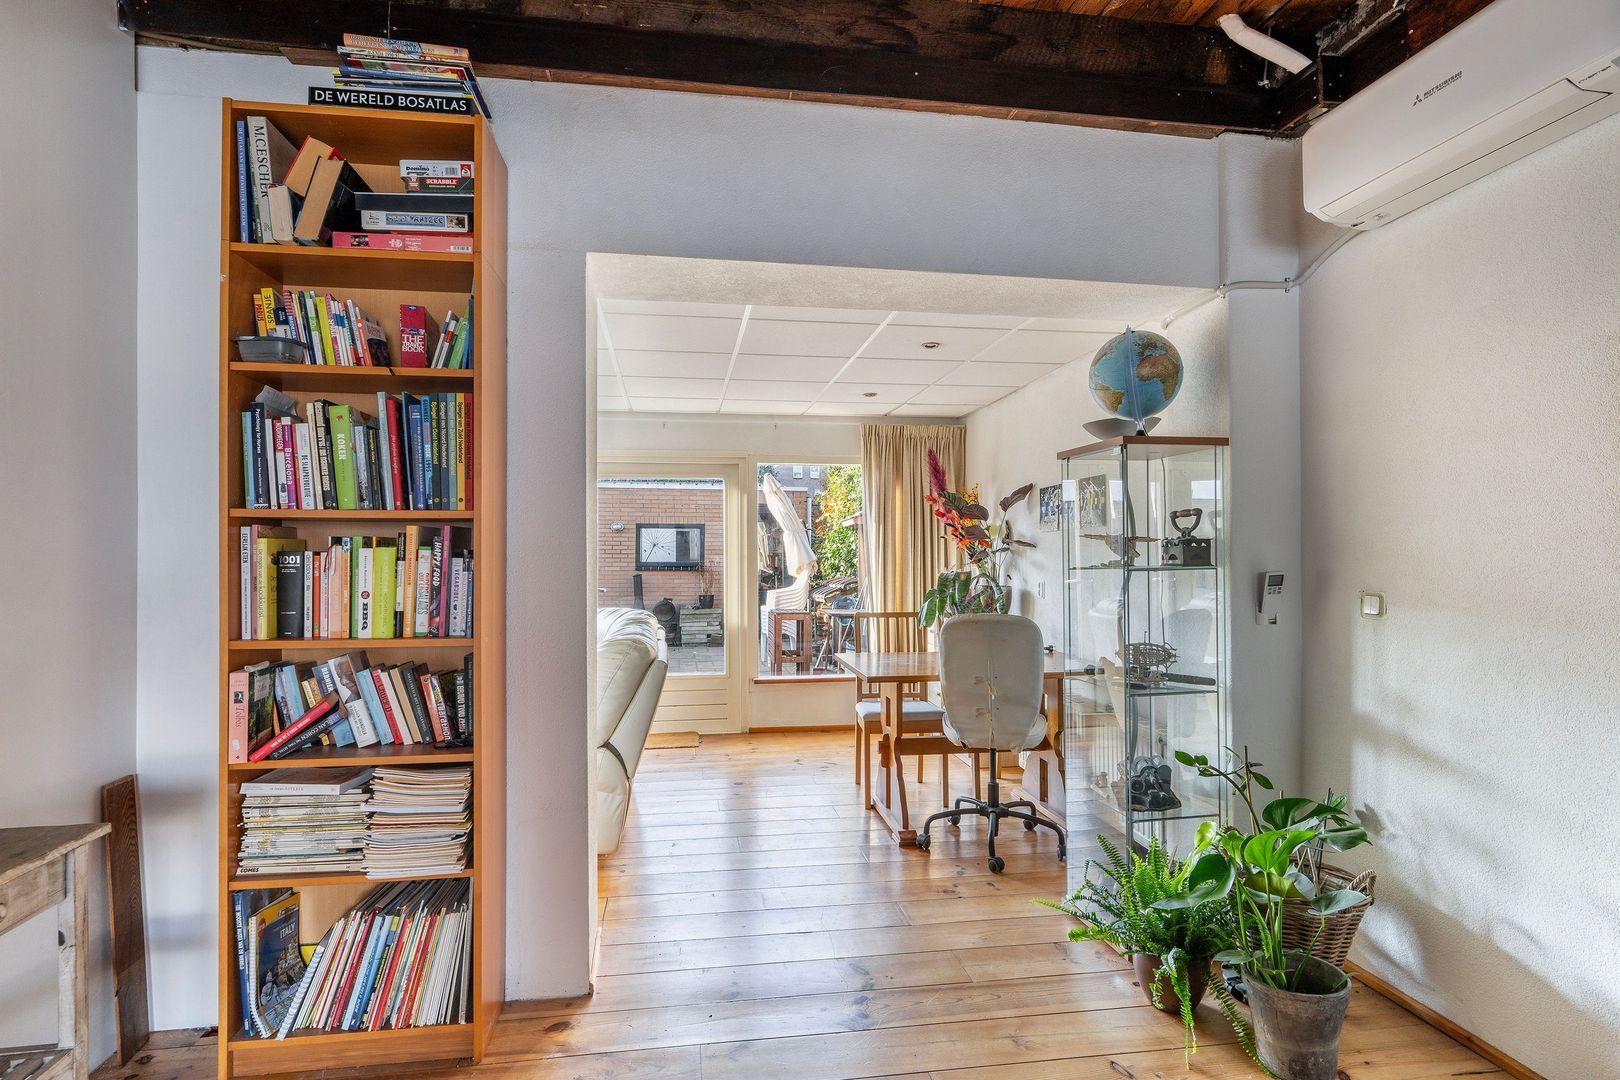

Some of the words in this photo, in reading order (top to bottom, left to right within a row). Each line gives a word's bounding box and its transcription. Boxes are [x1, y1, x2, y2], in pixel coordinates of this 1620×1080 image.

[314, 89, 334, 102] DE
[336, 91, 395, 107] WERELD
[398, 96, 467, 112] BOSATLAS
[255, 304, 265, 321] PARIJS
[264, 295, 274, 324] SPANJE
[402, 335, 424, 343] THE
[337, 433, 347, 460] KOKEN
[284, 448, 293, 484] Barcelona
[432, 568, 441, 586] FOOD
[456, 686, 465, 704] BRAVO
[457, 705, 465, 717] TWO
[300, 727, 319, 741] COBEN
[280, 922, 295, 938] ITALY
